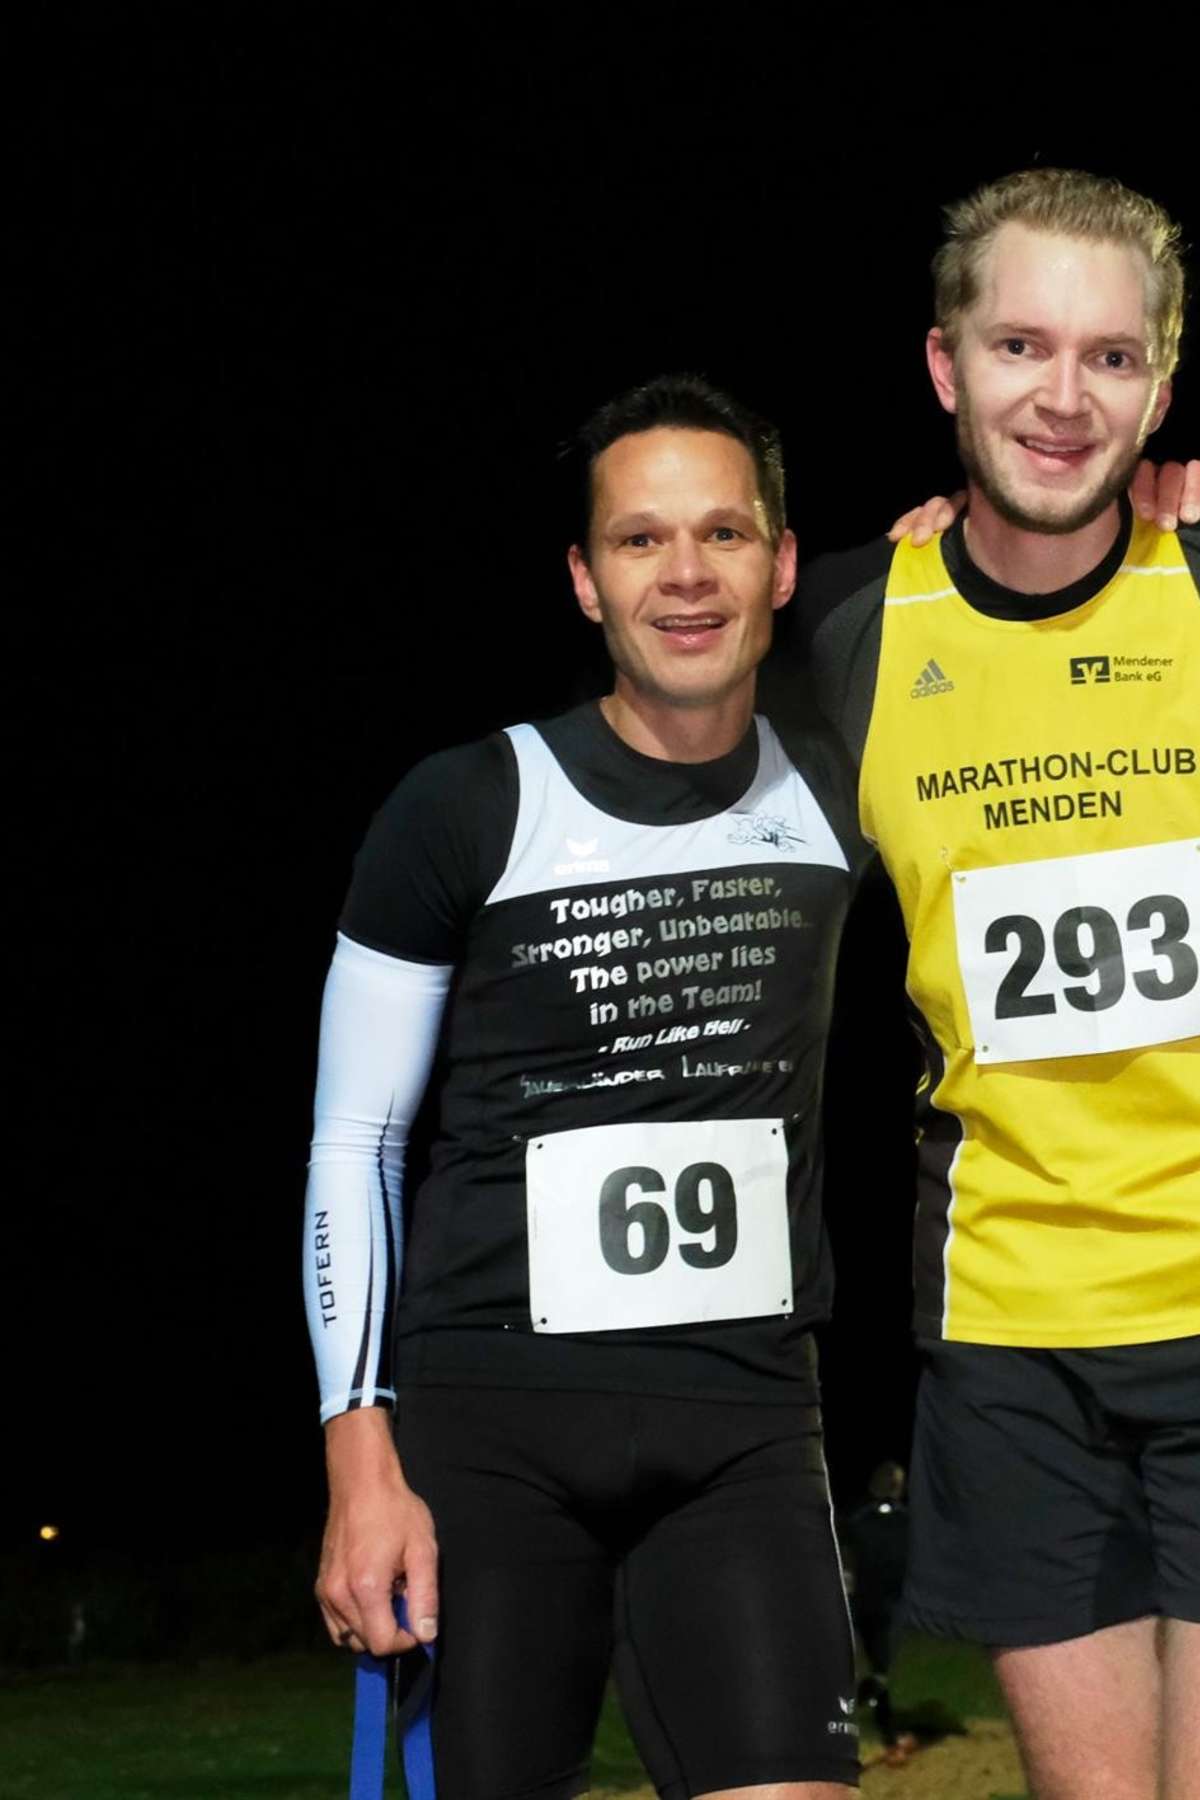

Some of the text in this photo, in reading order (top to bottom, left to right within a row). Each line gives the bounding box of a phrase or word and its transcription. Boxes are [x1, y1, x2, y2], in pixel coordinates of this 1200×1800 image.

[1113, 655, 1174, 667] Mendener
[1114, 670, 1162, 682] Bank eG
[910, 680, 954, 699] adidas
[916, 748, 1198, 802] MARATHON-CLUB
[984, 790, 1123, 830] MENDEN
[550, 874, 782, 924] Tougher, Faster,
[511, 926, 652, 968] Stronger,
[570, 943, 776, 993] The power lies
[984, 894, 1199, 1020] 293
[589, 979, 764, 1025] in the Team!
[611, 1033, 654, 1055] Run
[654, 1025, 700, 1046] Like
[598, 1161, 738, 1276] 69
[314, 1210, 337, 1329] TOFERN
